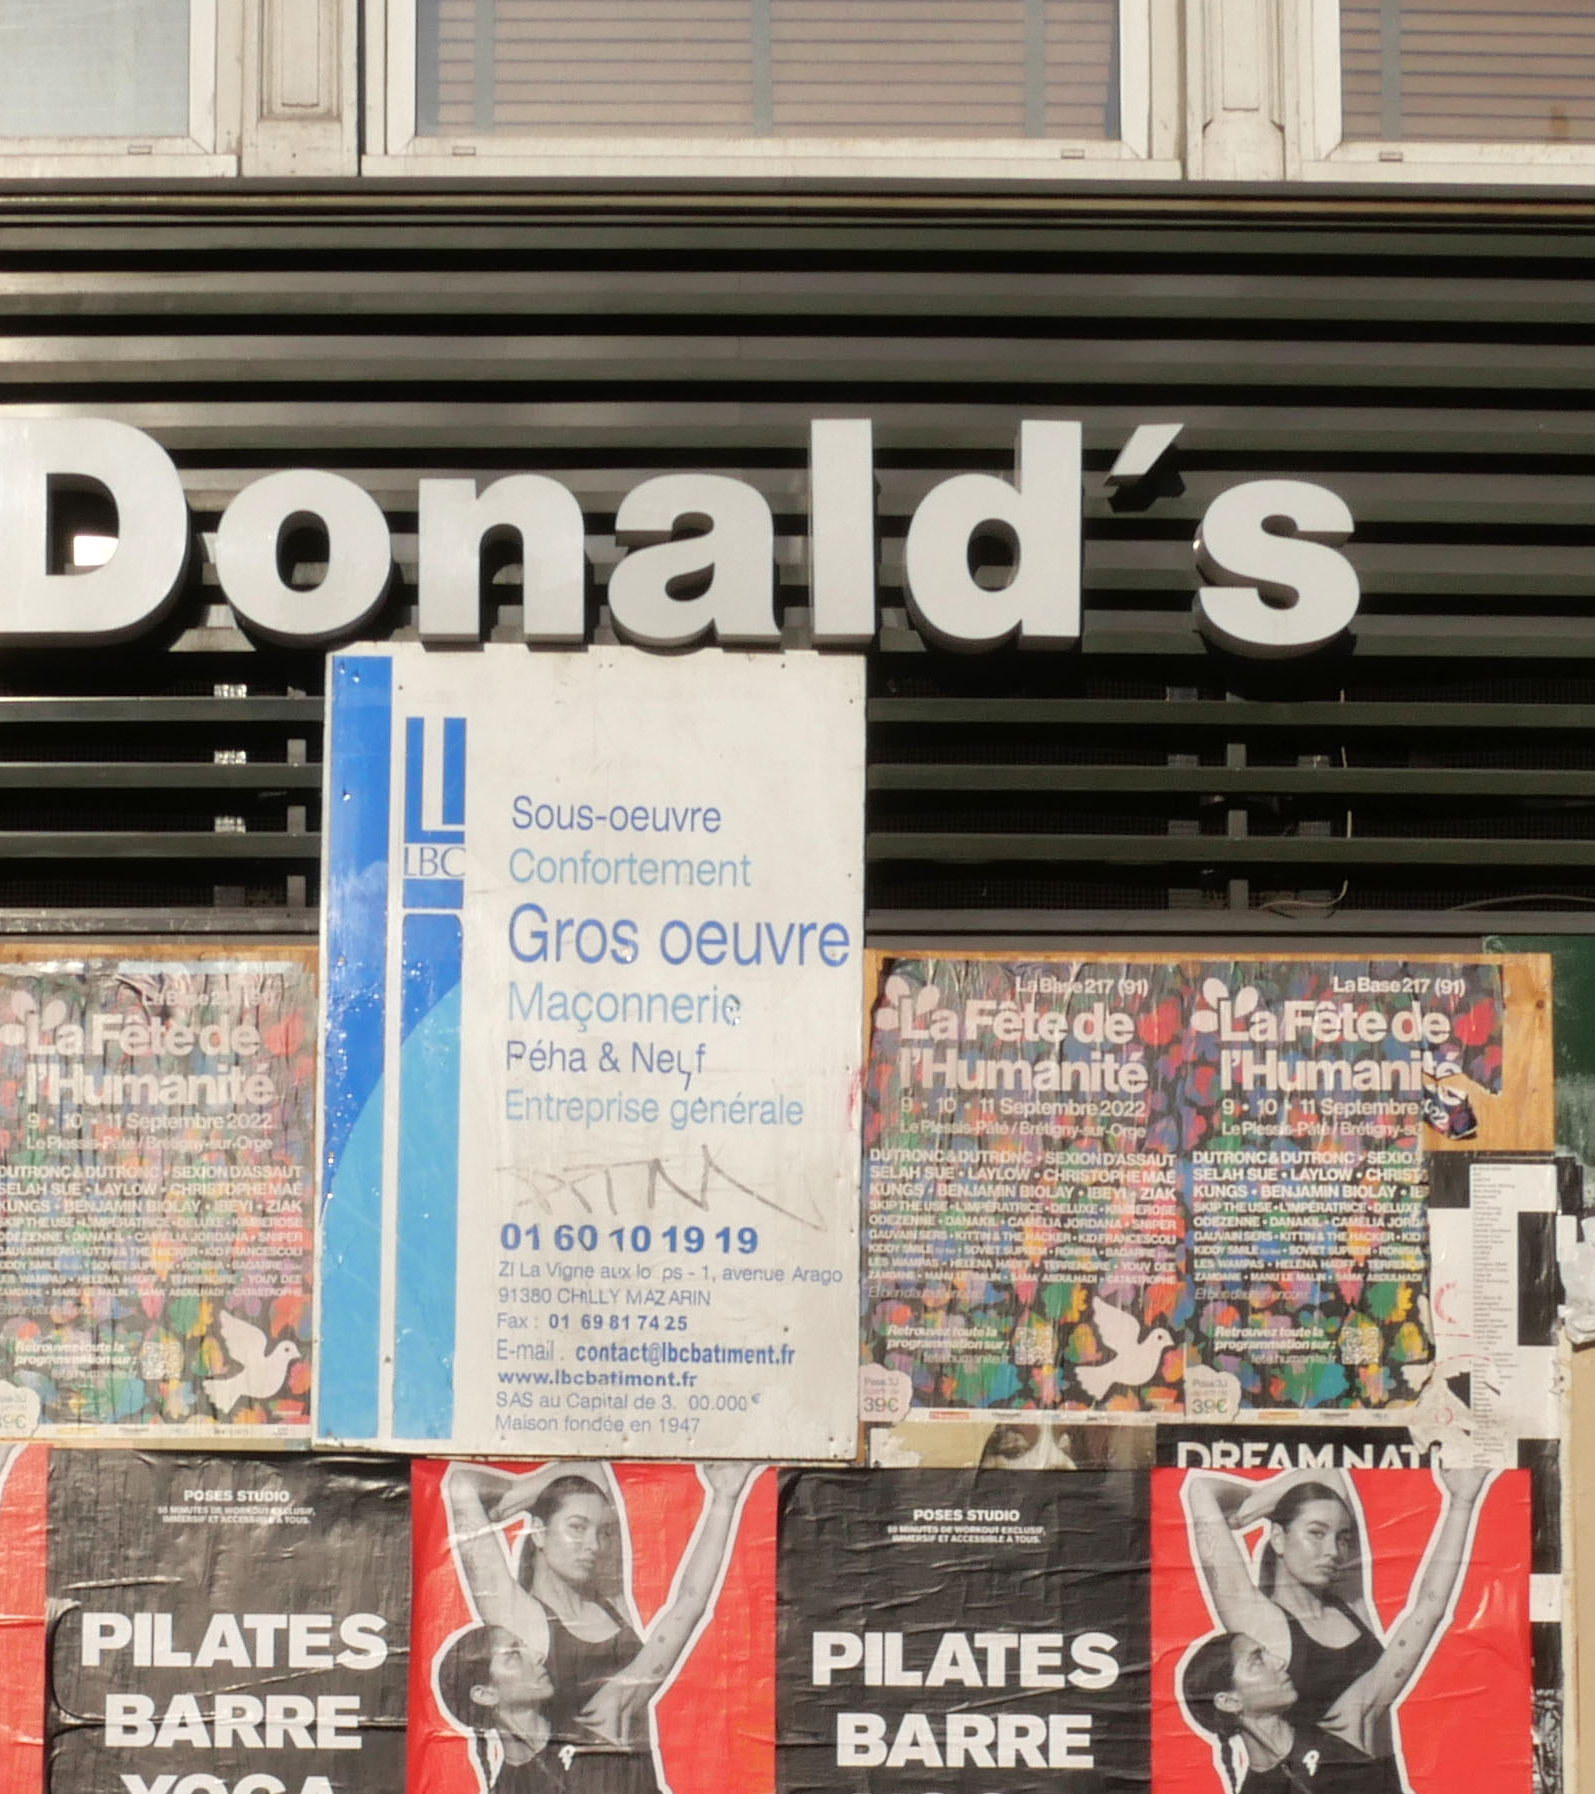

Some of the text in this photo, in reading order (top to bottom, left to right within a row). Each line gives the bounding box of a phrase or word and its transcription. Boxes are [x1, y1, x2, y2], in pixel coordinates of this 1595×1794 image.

[512, 795, 721, 832] Sous-oeuvre
[404, 846, 466, 878] LBC
[509, 848, 751, 887] Confortement
[509, 902, 850, 967] Gros oeuvre
[1016, 976, 1038, 994] La
[1086, 977, 1114, 995] 217
[1117, 977, 1149, 998] (91)
[509, 982, 742, 1032] Maçonnerie
[900, 996, 1135, 1044] La Fête de
[1220, 999, 1450, 1044] La Fête de
[27, 1011, 261, 1058] La Fête de
[599, 1041, 620, 1073] &
[900, 1047, 1148, 1093] l'Humanité
[506, 1089, 804, 1131] Entreprise générale
[1000, 1098, 1146, 1118] Septembre 2022
[501, 1222, 758, 1254] 01 60 10 19 19
[520, 1262, 540, 1278] La
[546, 1263, 595, 1282] Vigne
[722, 1268, 785, 1282] avenue
[792, 1266, 843, 1286] Arago
[499, 1288, 552, 1304] 91380
[497, 1313, 688, 1331] Fax 01 69 81 74 25
[576, 1342, 795, 1366] contact@lbcbatiment.fr
[496, 1392, 533, 1408] SAS
[539, 1396, 560, 1408] au
[566, 1392, 627, 1412] Capital
[634, 1393, 655, 1410] de
[495, 1414, 700, 1433] Maison fondée en 1947
[183, 1489, 290, 1502] POSES STUDIO
[913, 1508, 1020, 1522] POSES STUDIO
[82, 1611, 388, 1671] PILATES
[812, 1631, 1119, 1690] PILATES
[105, 1694, 362, 1750] BARRE
[837, 1713, 1094, 1769] BARRE
